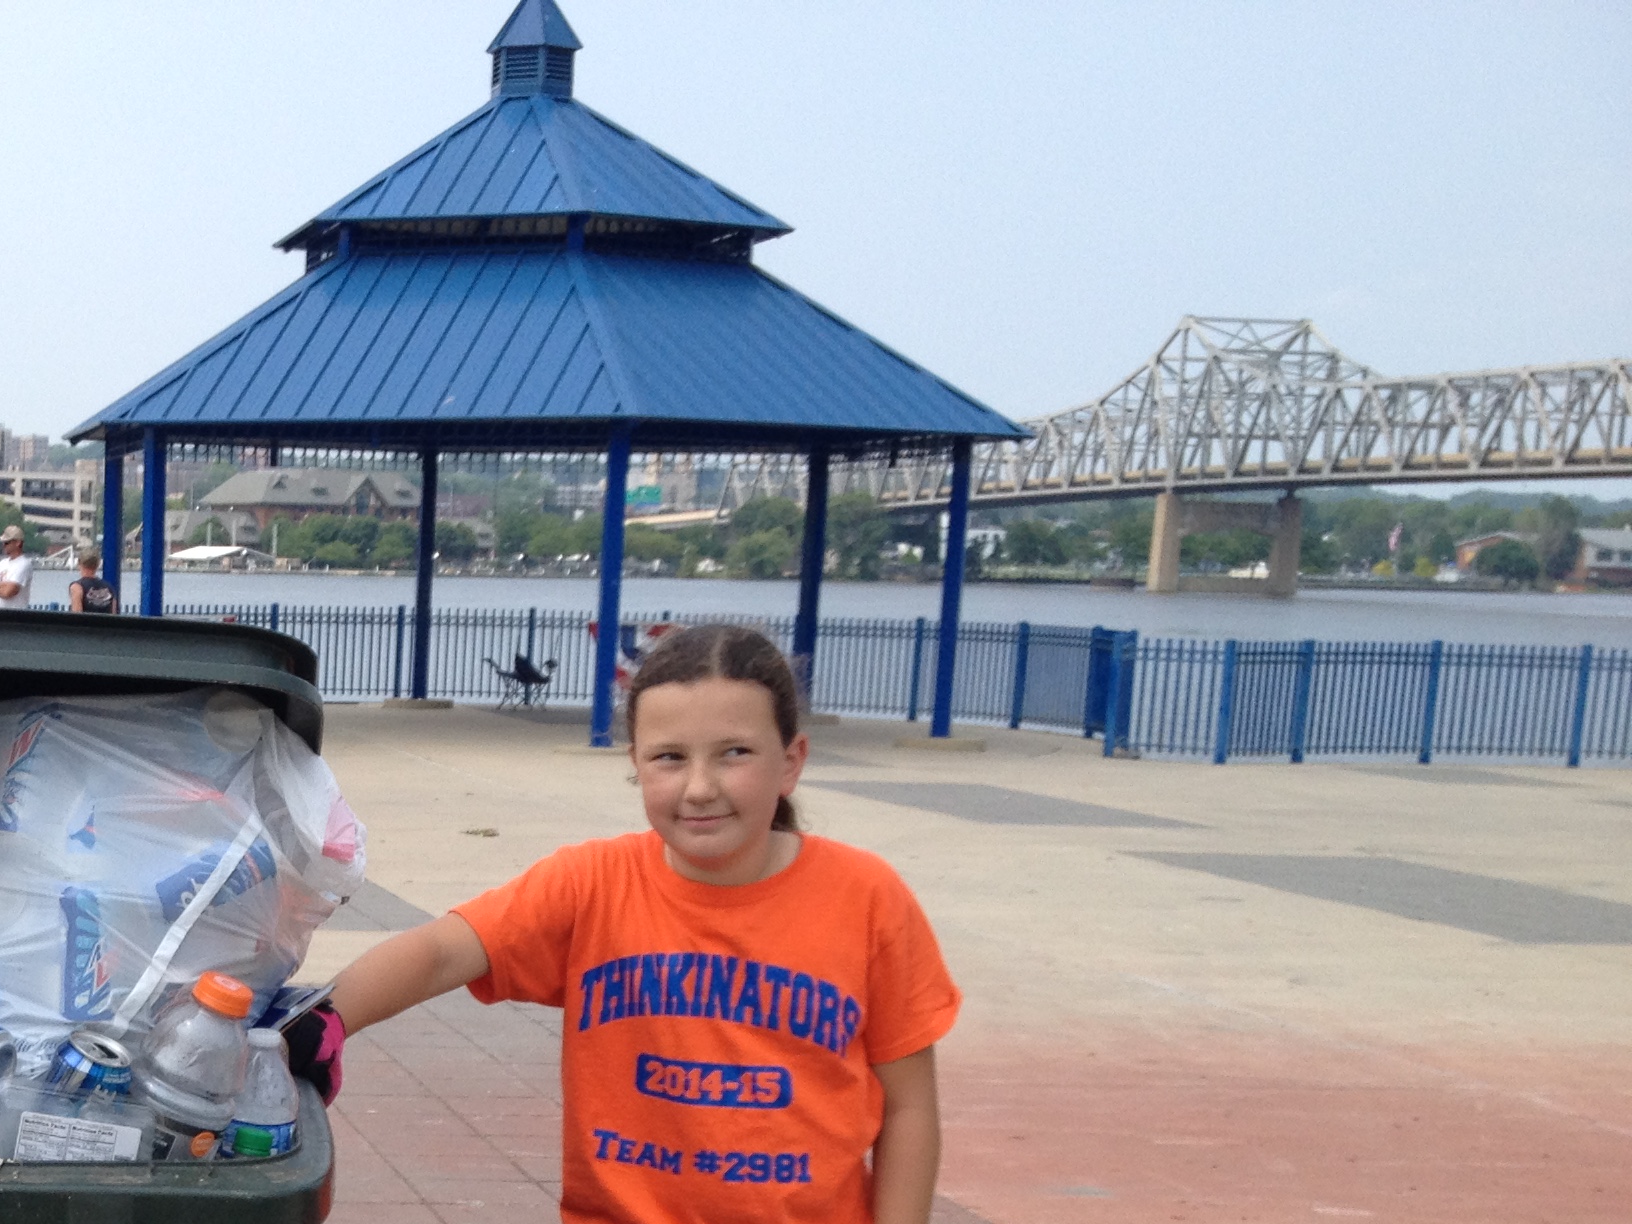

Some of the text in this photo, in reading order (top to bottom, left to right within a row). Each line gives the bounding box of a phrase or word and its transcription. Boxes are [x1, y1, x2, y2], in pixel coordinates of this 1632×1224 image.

[577, 952, 862, 1059] THINKINATORS
[643, 1058, 781, 1104] 2014-15
[593, 1128, 812, 1184] TEAM #2981
